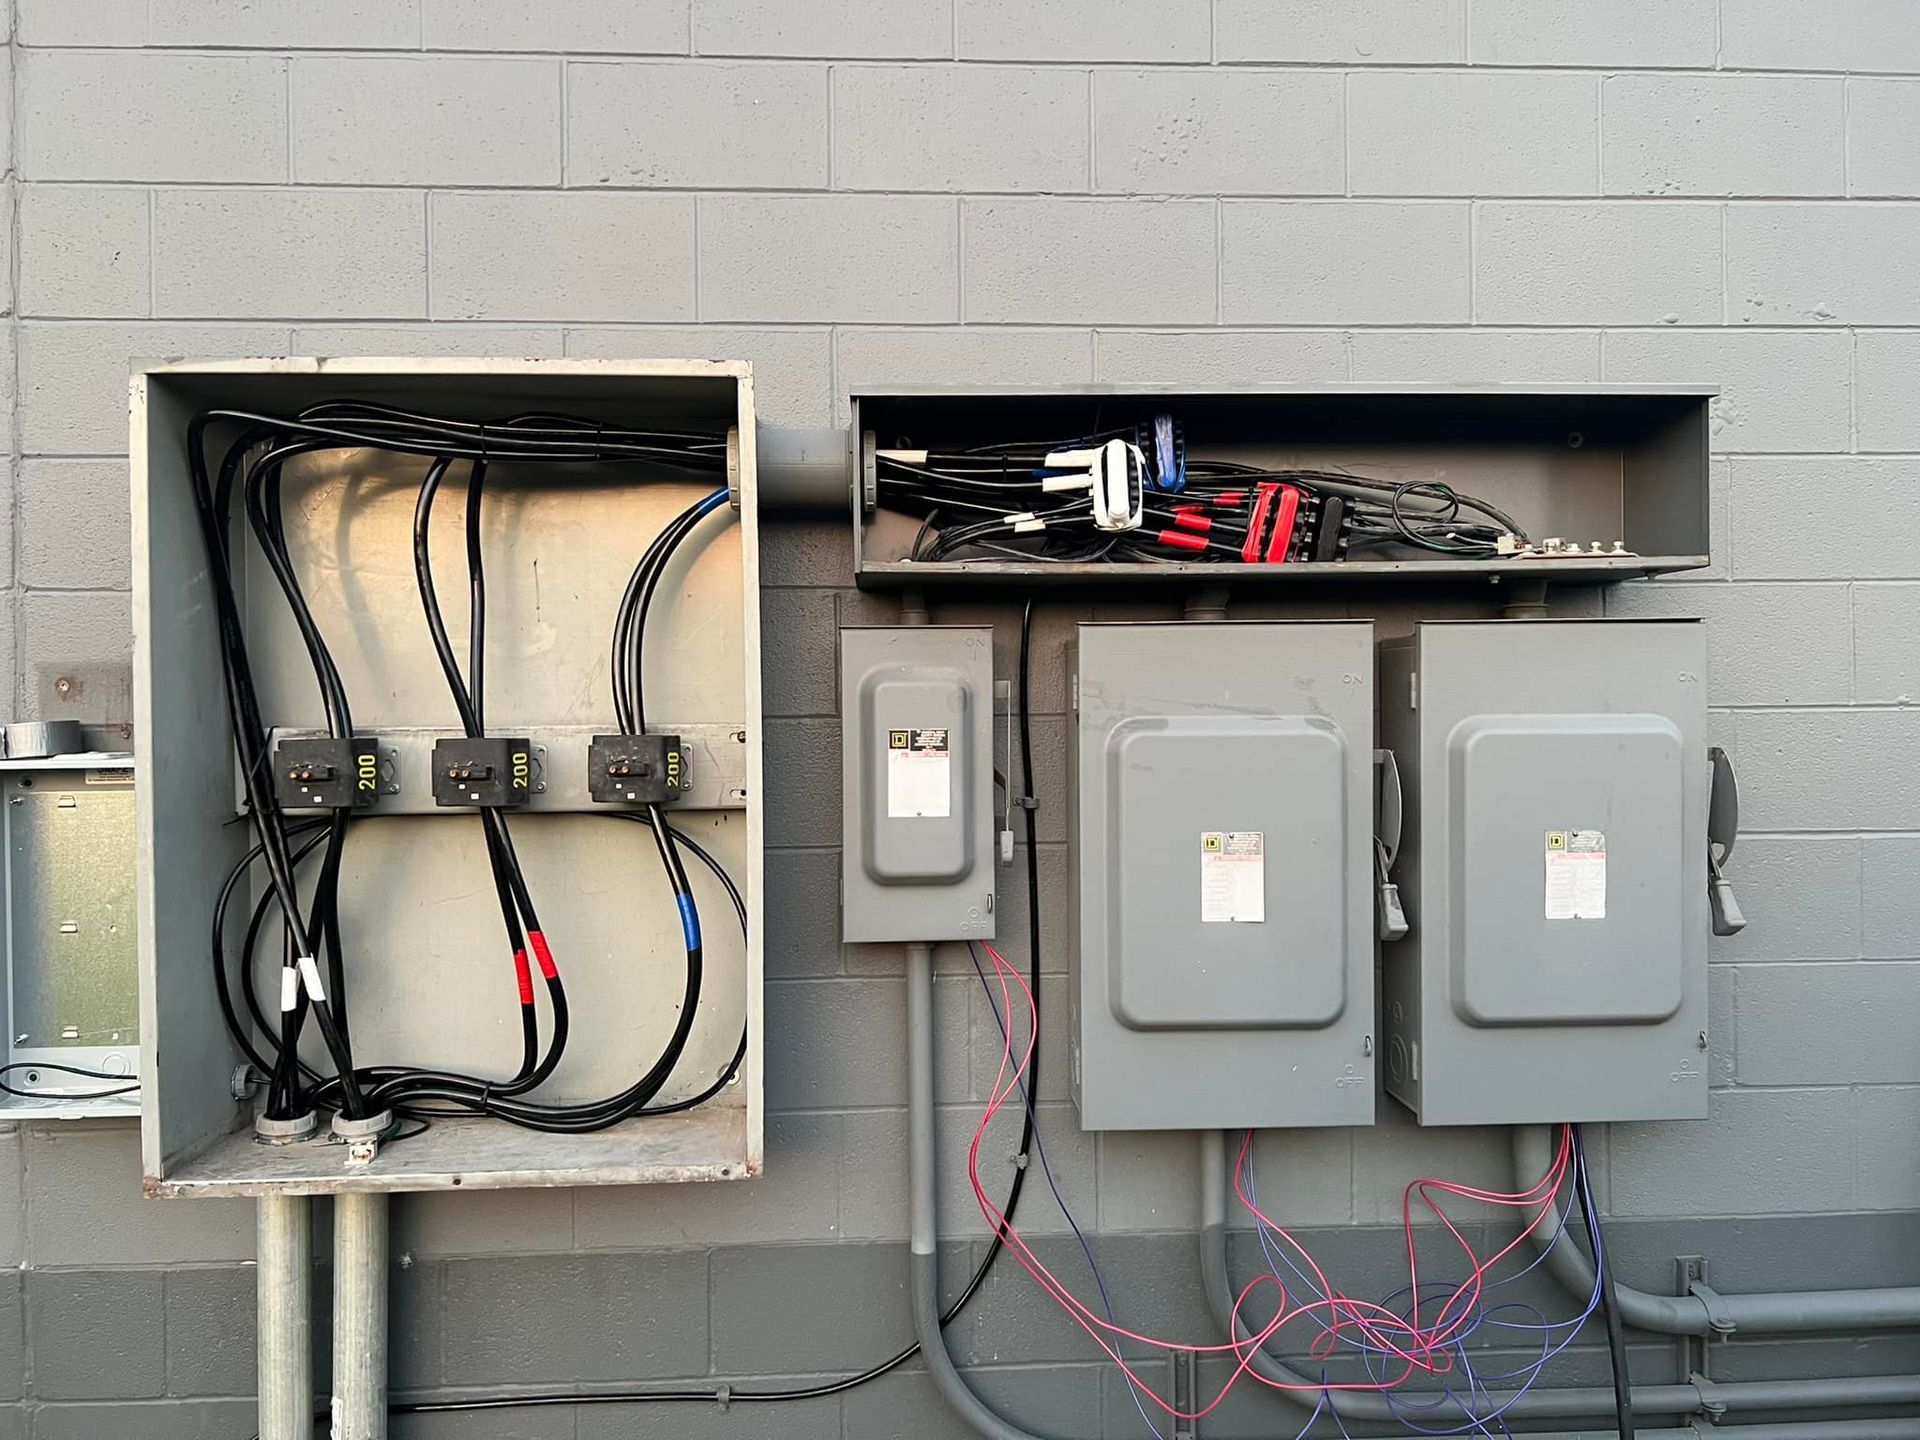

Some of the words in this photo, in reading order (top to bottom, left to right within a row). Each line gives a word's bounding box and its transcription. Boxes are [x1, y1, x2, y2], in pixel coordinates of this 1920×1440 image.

[358, 754, 377, 791] 200
[512, 752, 529, 788] 200
[667, 752, 680, 787] 200
